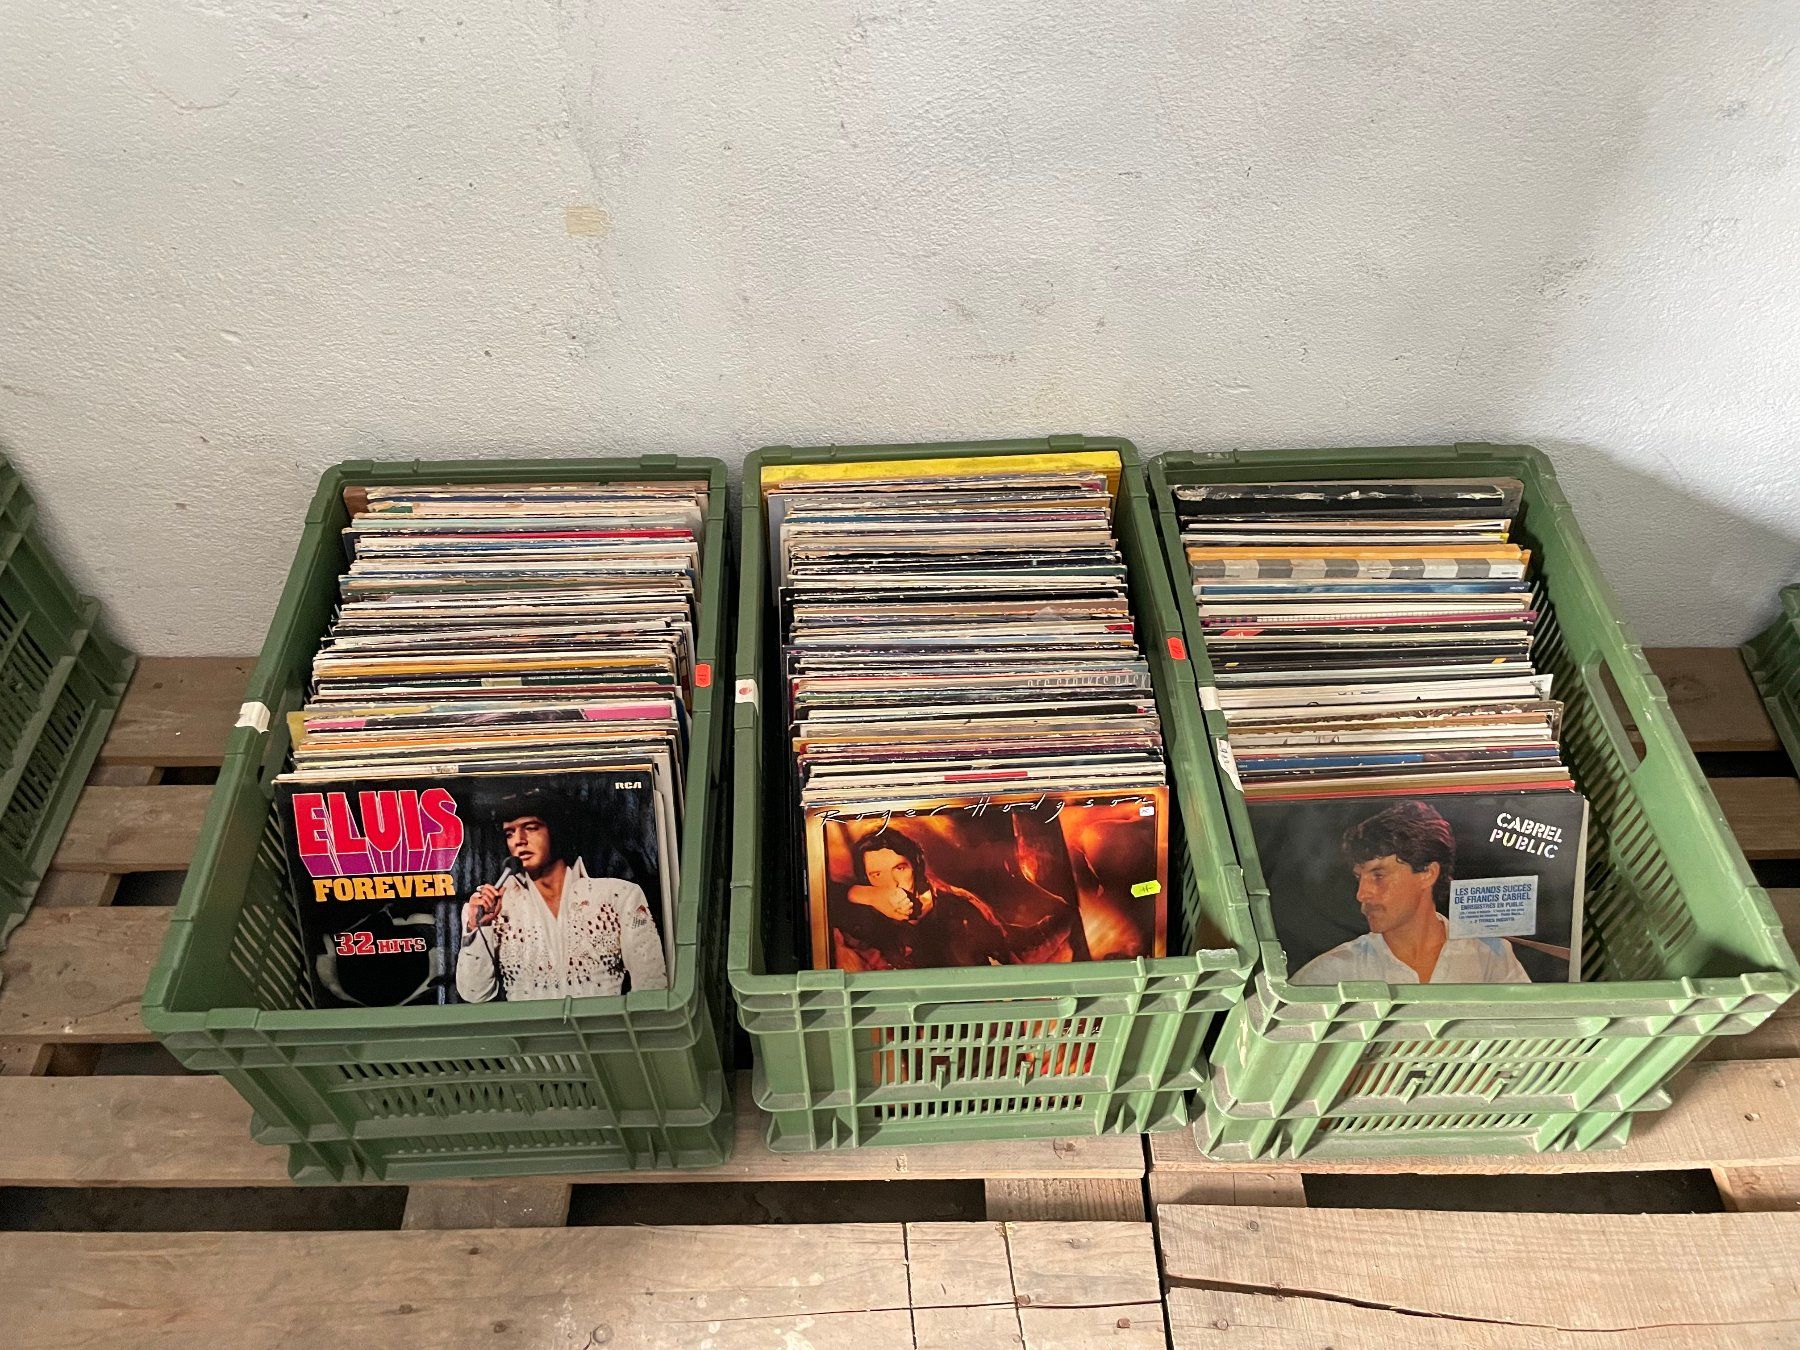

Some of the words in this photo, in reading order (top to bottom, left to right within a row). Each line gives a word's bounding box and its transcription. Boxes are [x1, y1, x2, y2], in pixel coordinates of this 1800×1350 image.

[614, 781, 642, 790] RCA
[814, 804, 951, 837] Roger
[963, 793, 1154, 824] Hodgson
[1496, 812, 1563, 843] CABREL
[1489, 828, 1559, 859] PUBLIC
[312, 874, 456, 902] FOREVER
[1454, 896, 1464, 904] DE
[1467, 894, 1499, 903] FRANCIS
[1502, 892, 1531, 901] CABREL
[1455, 887, 1468, 895] LES
[1470, 886, 1500, 894] GRANDS
[334, 931, 376, 956] 32
[377, 937, 427, 954] HITS
